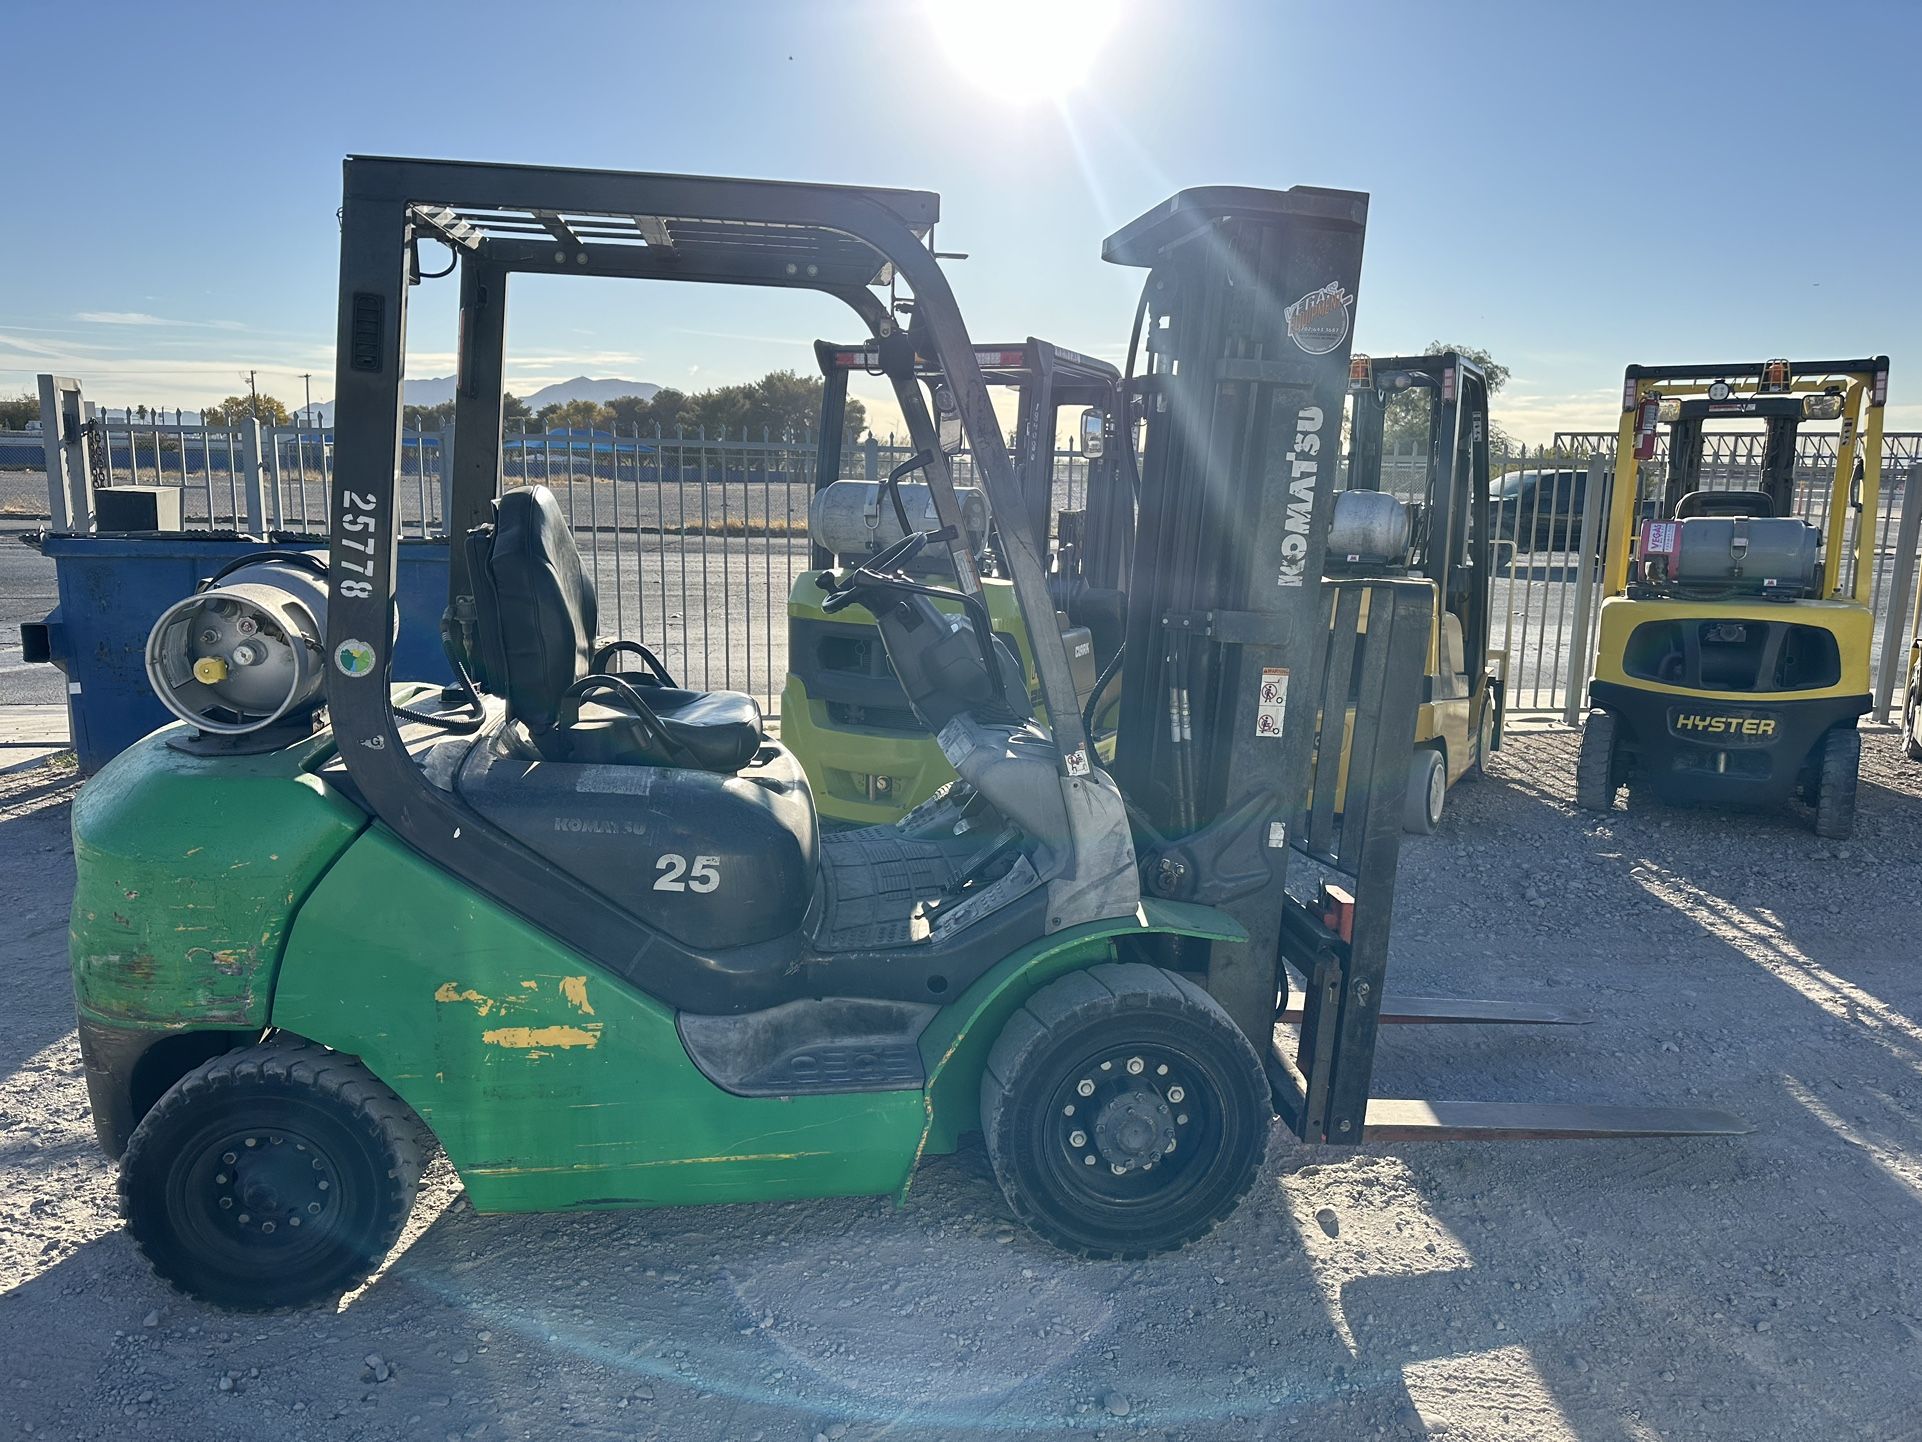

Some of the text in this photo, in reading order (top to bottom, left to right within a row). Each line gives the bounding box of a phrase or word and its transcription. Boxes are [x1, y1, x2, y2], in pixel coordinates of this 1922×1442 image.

[1278, 406, 1324, 586] KOMATSU
[340, 490, 377, 598] 25778
[1676, 714, 1777, 735] HYSTER
[653, 853, 721, 894] 25
